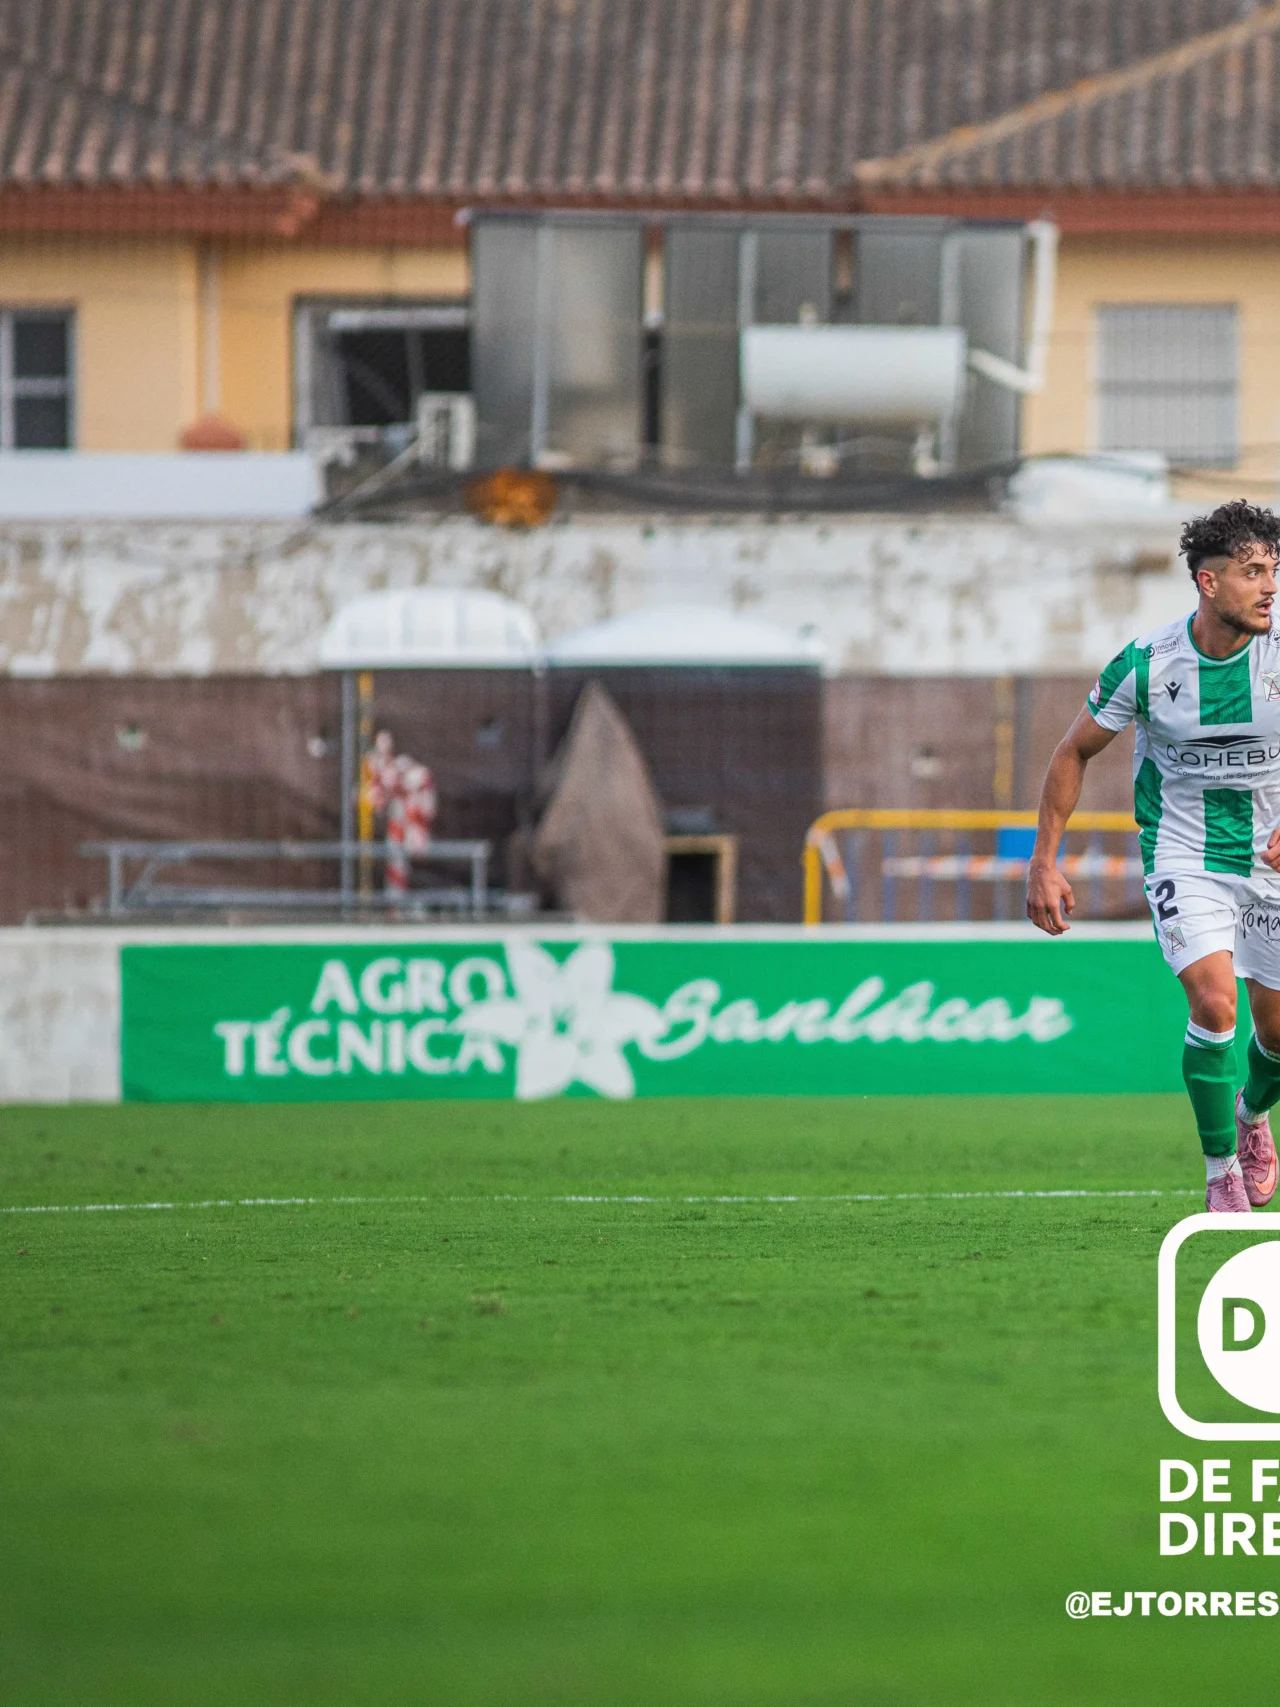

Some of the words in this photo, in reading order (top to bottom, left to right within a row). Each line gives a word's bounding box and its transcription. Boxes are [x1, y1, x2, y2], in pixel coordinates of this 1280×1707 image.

[1223, 772, 1234, 780] de
[1237, 769, 1270, 780] Seguros
[1155, 879, 1179, 923] 2
[311, 956, 507, 1014] AGRO
[213, 1006, 505, 1077] TÉCNICA
